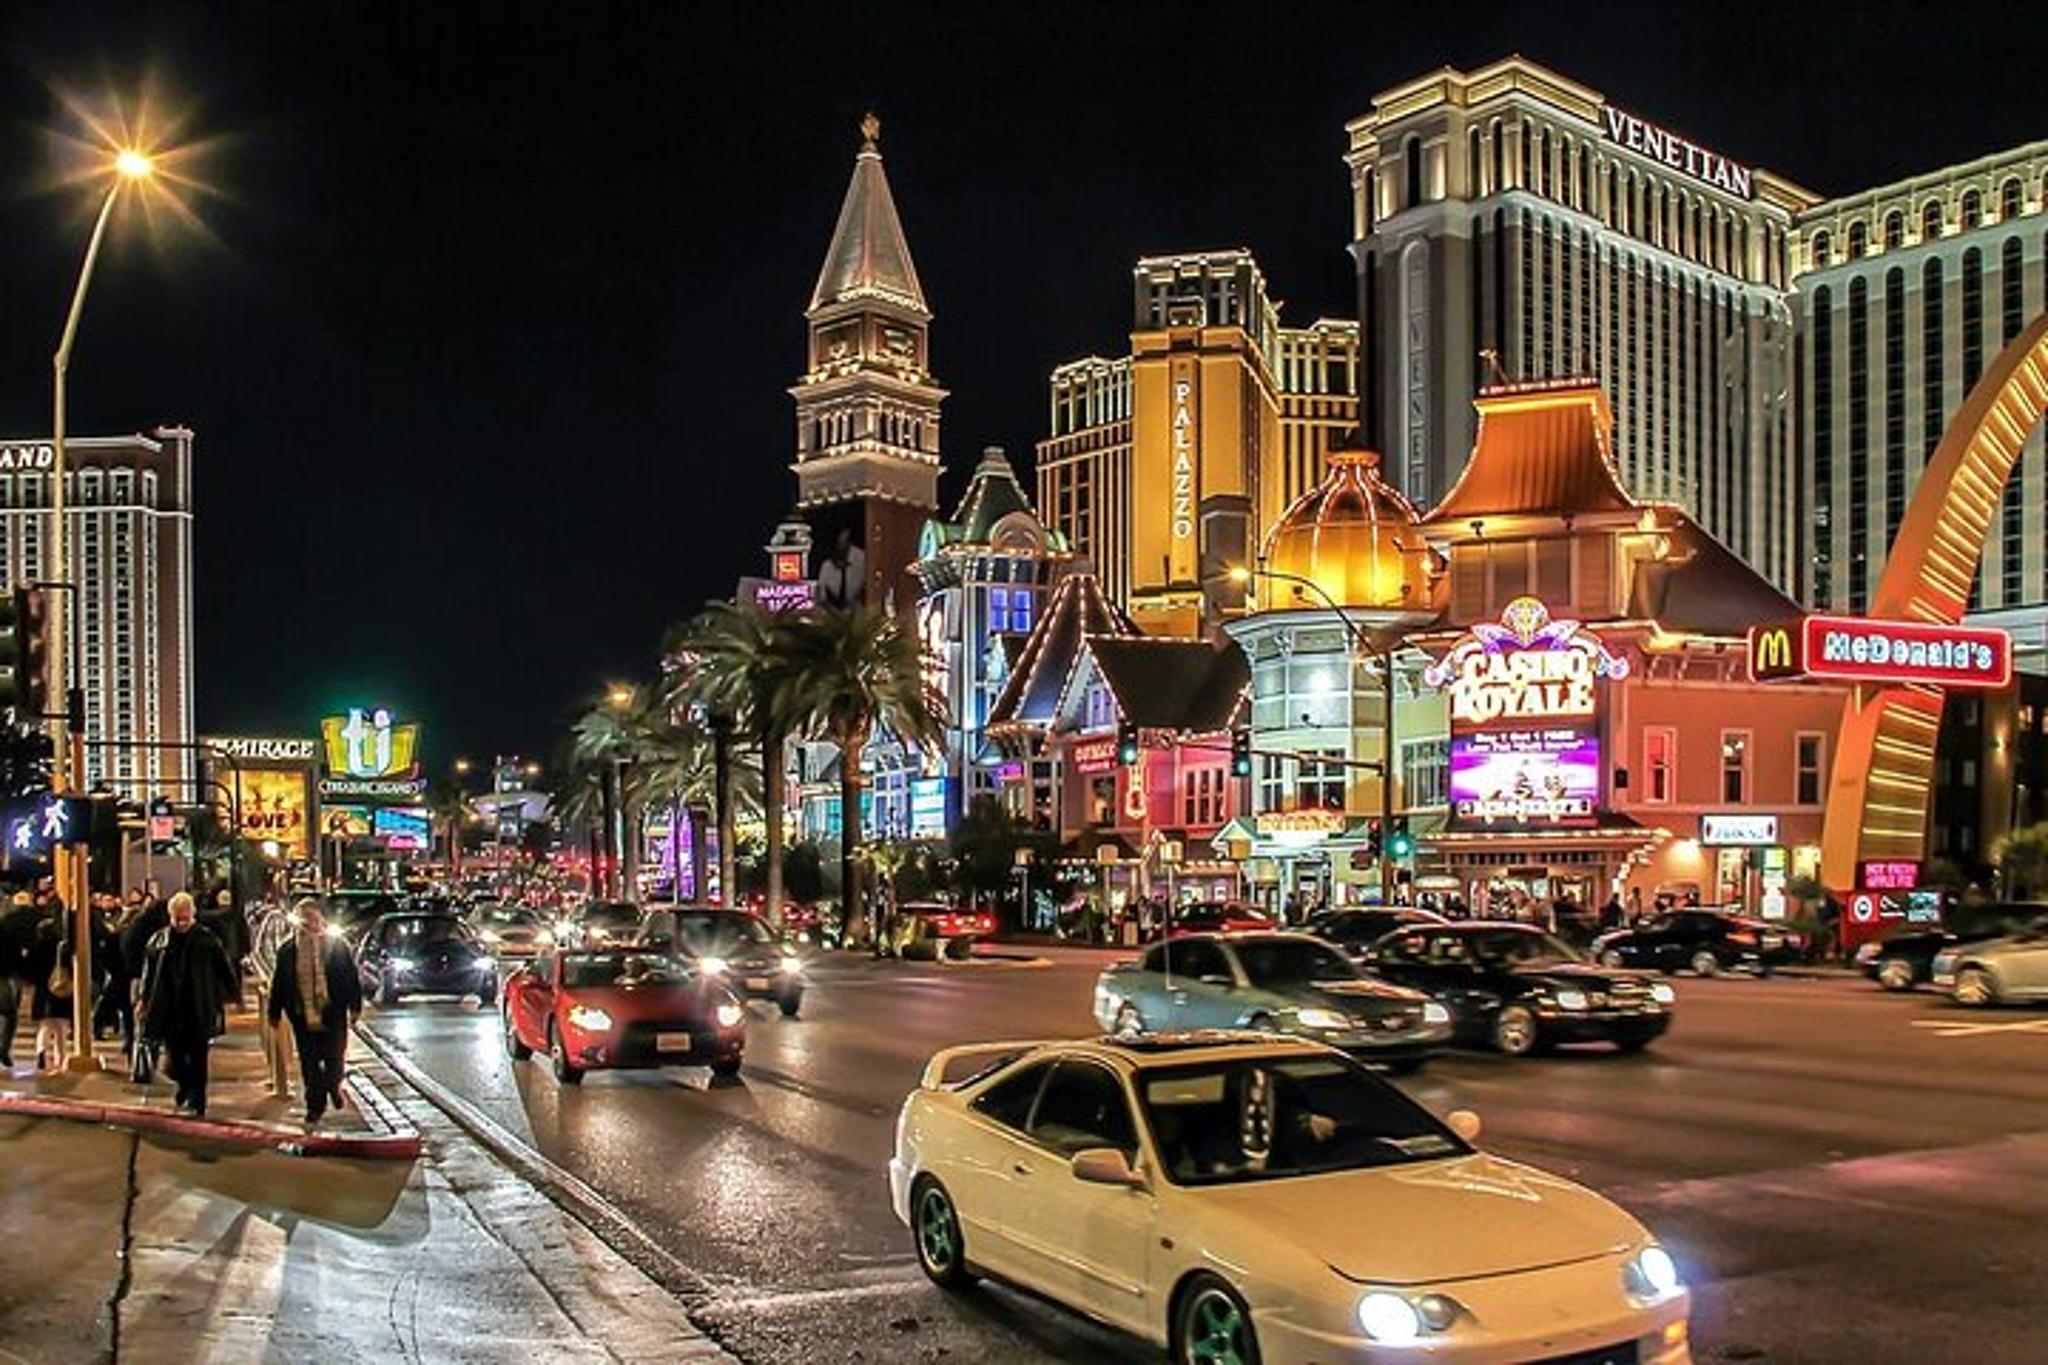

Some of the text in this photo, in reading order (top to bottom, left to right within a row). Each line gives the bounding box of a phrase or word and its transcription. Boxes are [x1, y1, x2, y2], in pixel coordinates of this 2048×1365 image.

[1605, 104, 1751, 199] VENETIAN
[1173, 383, 1193, 538] PALAZZO
[1463, 649, 1589, 682] CASINO
[1823, 631, 1992, 670] McDonald's
[1452, 677, 1595, 722] ROYALE
[229, 739, 314, 759] MIRAGE
